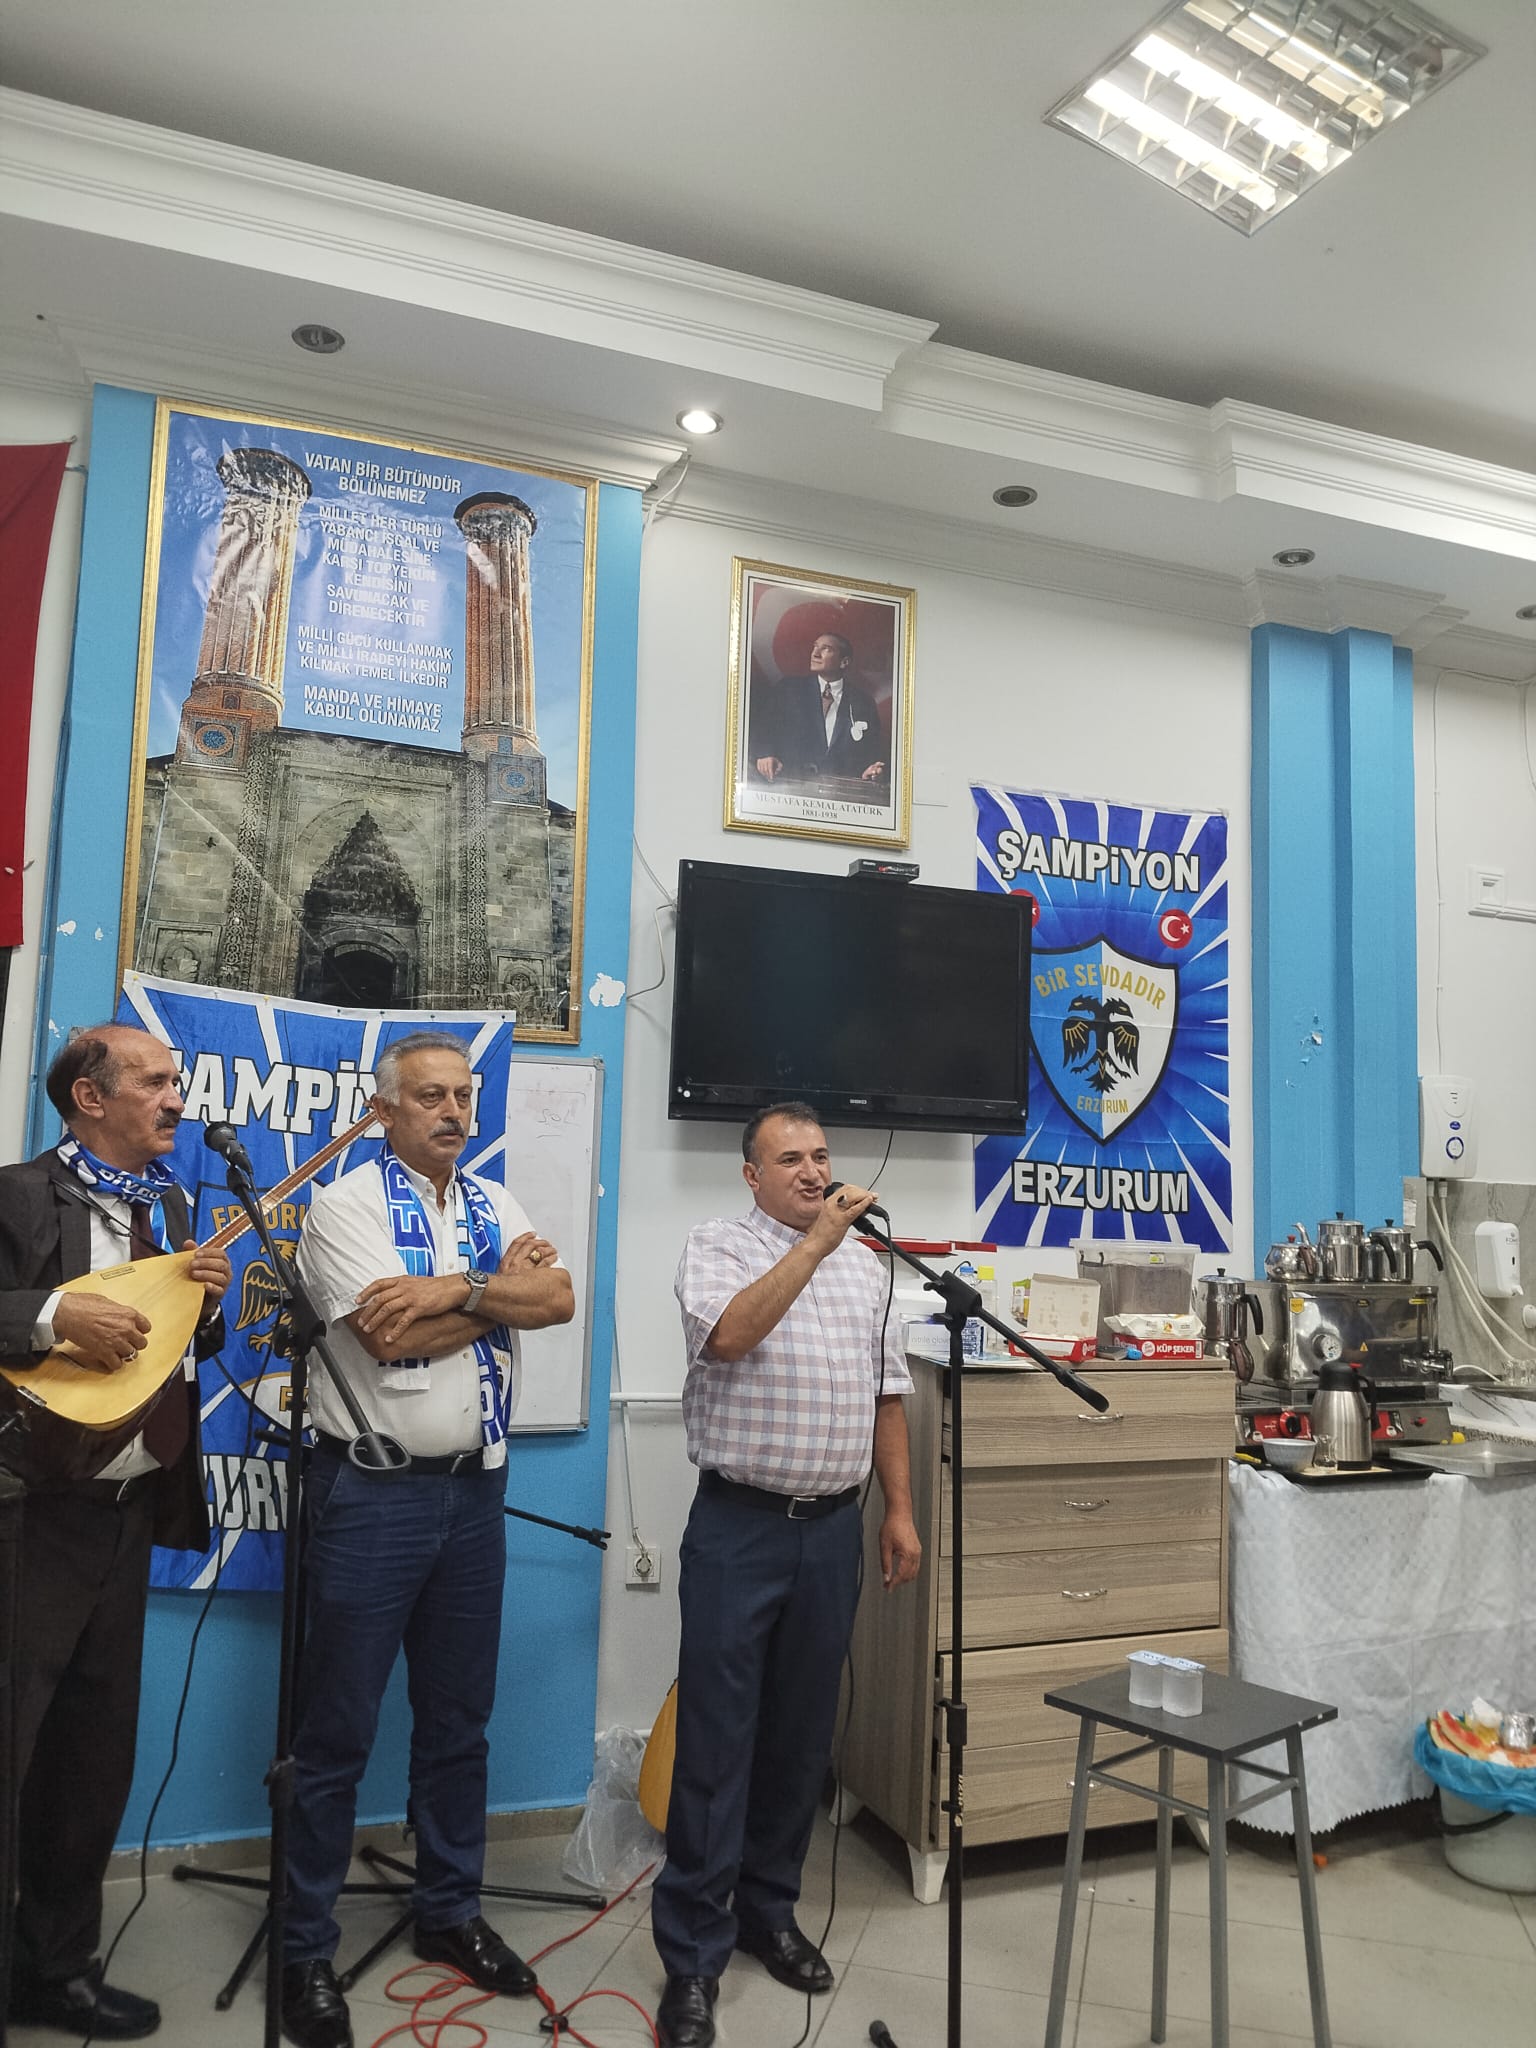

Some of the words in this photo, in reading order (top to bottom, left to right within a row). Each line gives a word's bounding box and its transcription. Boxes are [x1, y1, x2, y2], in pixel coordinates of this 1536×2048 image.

[305, 452, 352, 474] VATAN
[355, 460, 381, 480] BİR
[384, 466, 462, 494] BÜTÜNDÜR
[338, 476, 427, 504] BÖLÜNEMEZ
[319, 505, 368, 525] MİLLET
[371, 514, 397, 531] HER
[400, 520, 443, 538] TÜRLÜ
[320, 521, 379, 541] YABANCI
[423, 539, 440, 553] VE
[327, 584, 408, 609] SAVUNMACAK
[411, 598, 431, 612] VE
[329, 600, 425, 627] DİRENECEKTİR
[298, 625, 333, 642] MİLLİ
[337, 631, 372, 649] GÜCÜ
[375, 638, 453, 660] KULLANMAK
[298, 640, 314, 654] VE
[410, 657, 452, 675] HAKİM
[300, 656, 351, 674] KILMAK
[354, 663, 396, 681] TEMEL
[399, 668, 449, 689] İLKEDİR
[304, 684, 360, 706] MANDA
[364, 693, 383, 709] VE
[387, 695, 443, 718] HİMAYE
[304, 700, 355, 721] KABUL
[358, 709, 440, 733] OLUNAMAZ
[755, 791, 800, 807] MUSTAFA
[802, 800, 838, 811] KEMAL
[802, 809, 838, 819] 1881-1938
[1074, 964, 1166, 1010] SEVDADIR
[1077, 1095, 1129, 1113] ERZURUM
[1012, 1160, 1190, 1214] ERZURUM
[1156, 1343, 1172, 1353] KÜP
[1172, 1344, 1195, 1355] ŞEKER
